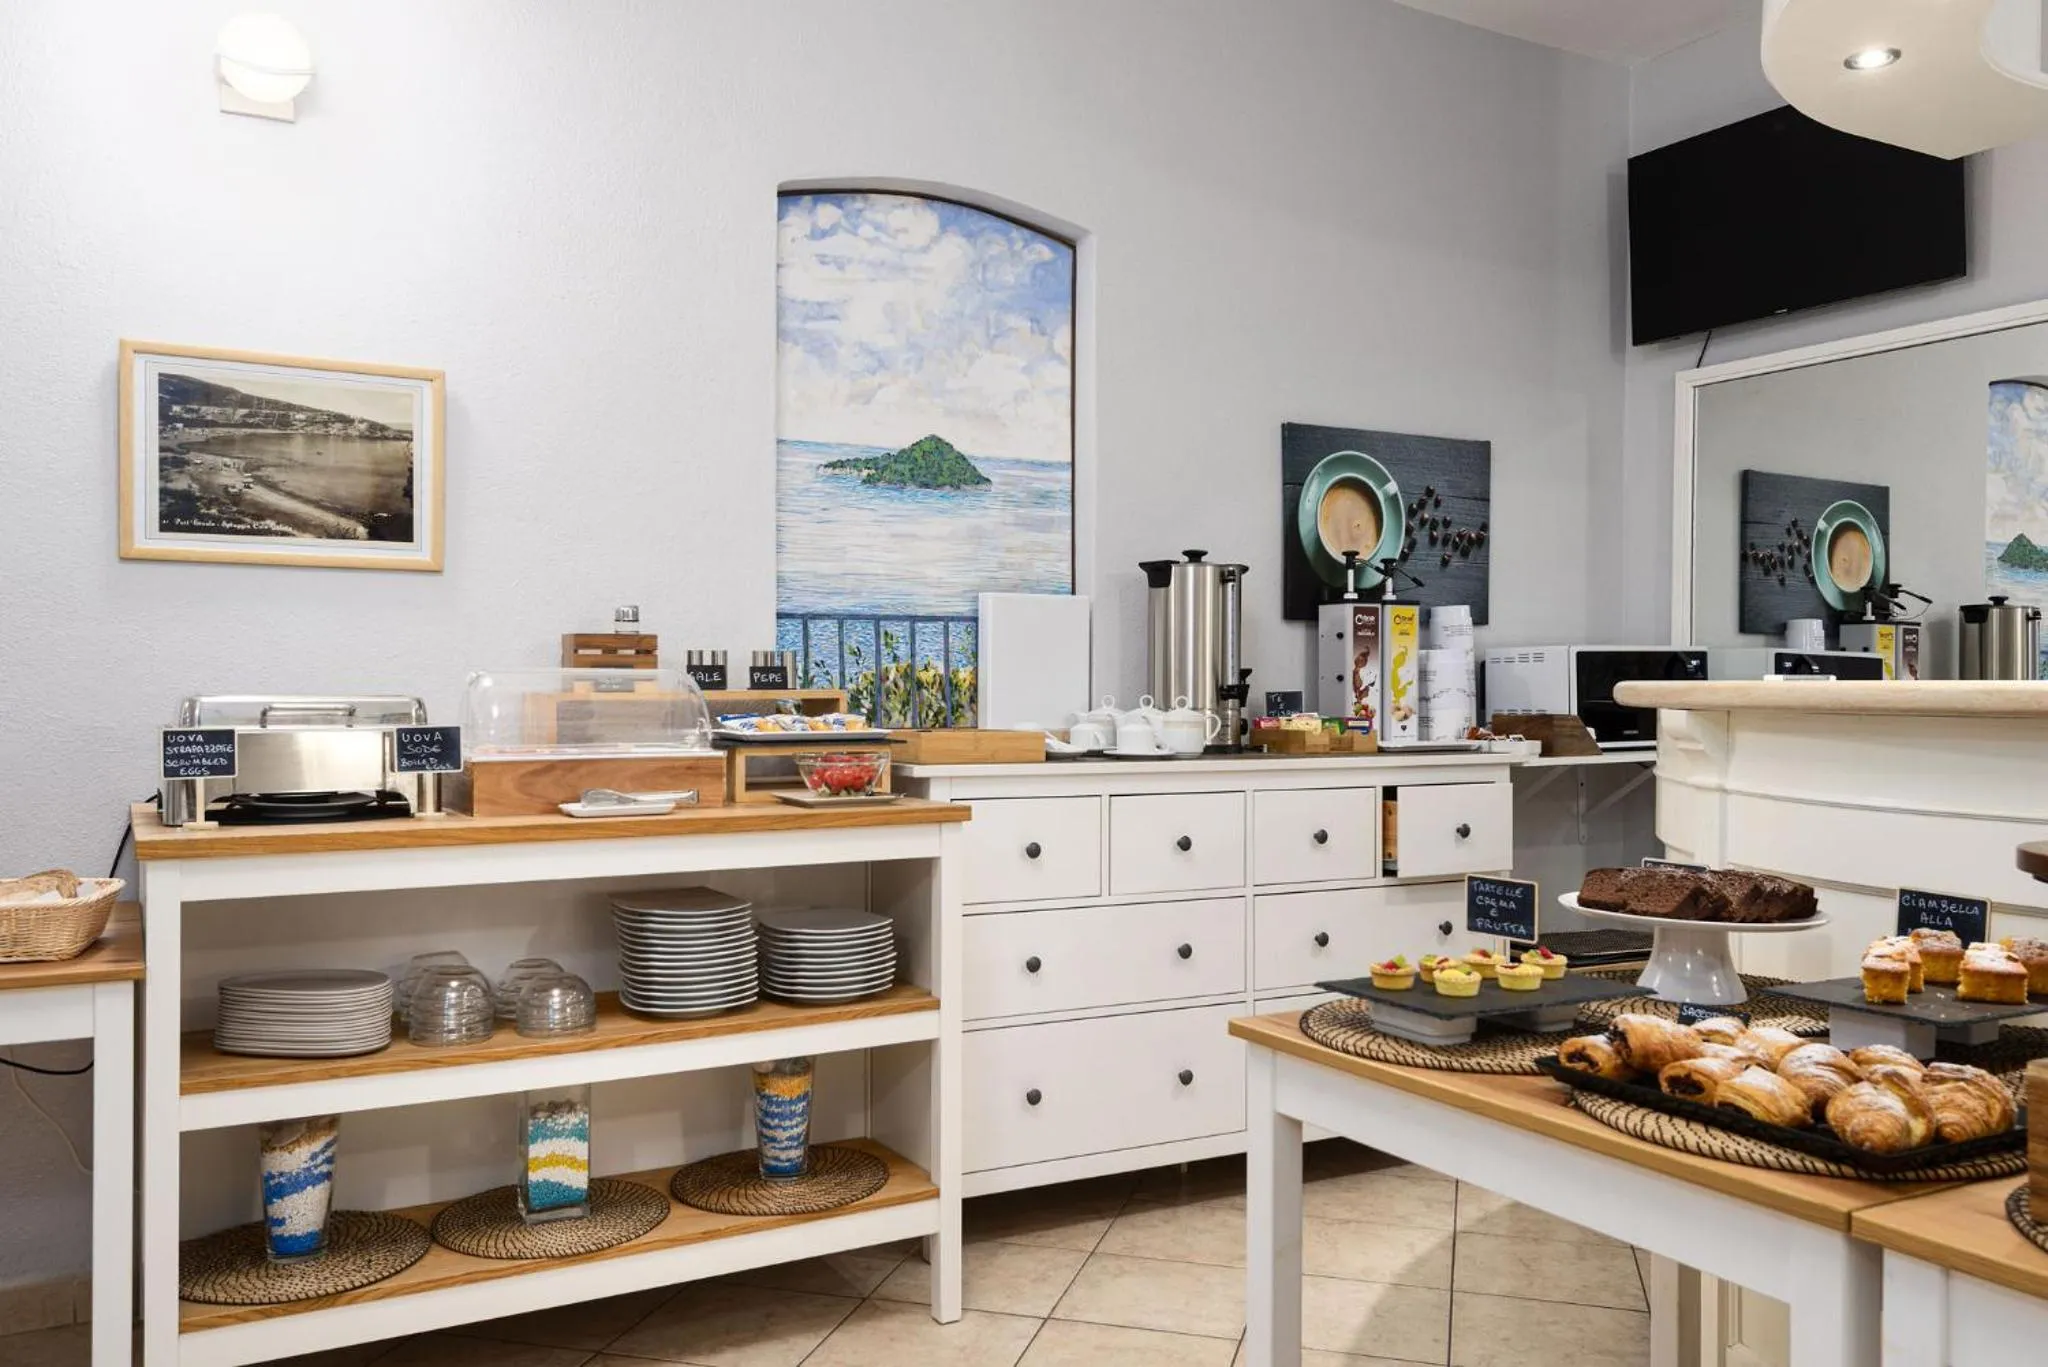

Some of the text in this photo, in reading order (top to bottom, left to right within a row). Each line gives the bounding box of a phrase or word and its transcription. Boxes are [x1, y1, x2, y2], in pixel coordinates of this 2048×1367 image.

[752, 671, 783, 684] PEPE
[167, 733, 204, 743] UOVA
[402, 731, 444, 743] UOVA
[403, 744, 442, 755] SODE
[180, 766, 211, 776] EGGS
[1476, 895, 1517, 911] CREMA
[1920, 911, 1953, 928] ALLA
[1475, 917, 1528, 936] FRUTTA
